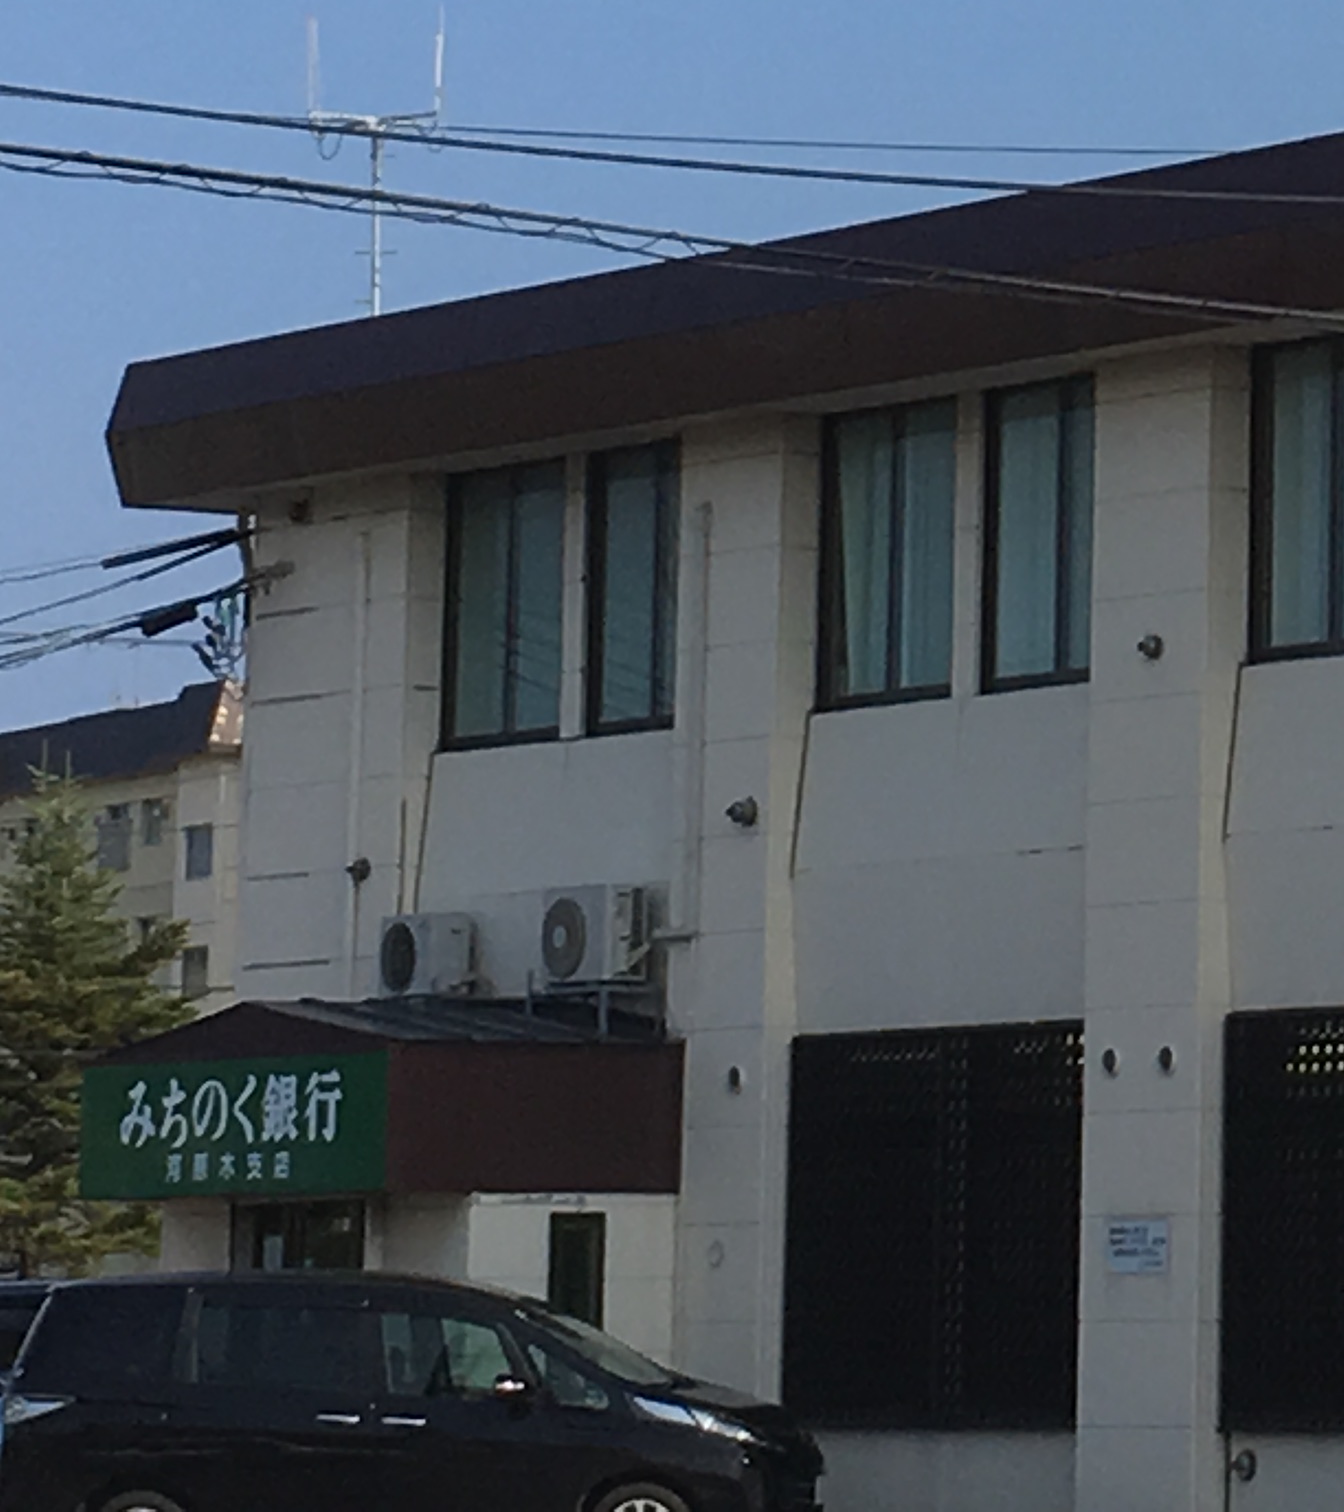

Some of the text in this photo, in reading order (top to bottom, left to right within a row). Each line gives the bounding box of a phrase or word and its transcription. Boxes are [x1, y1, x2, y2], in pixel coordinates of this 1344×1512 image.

[119, 1067, 344, 1149] みちのく銀行
